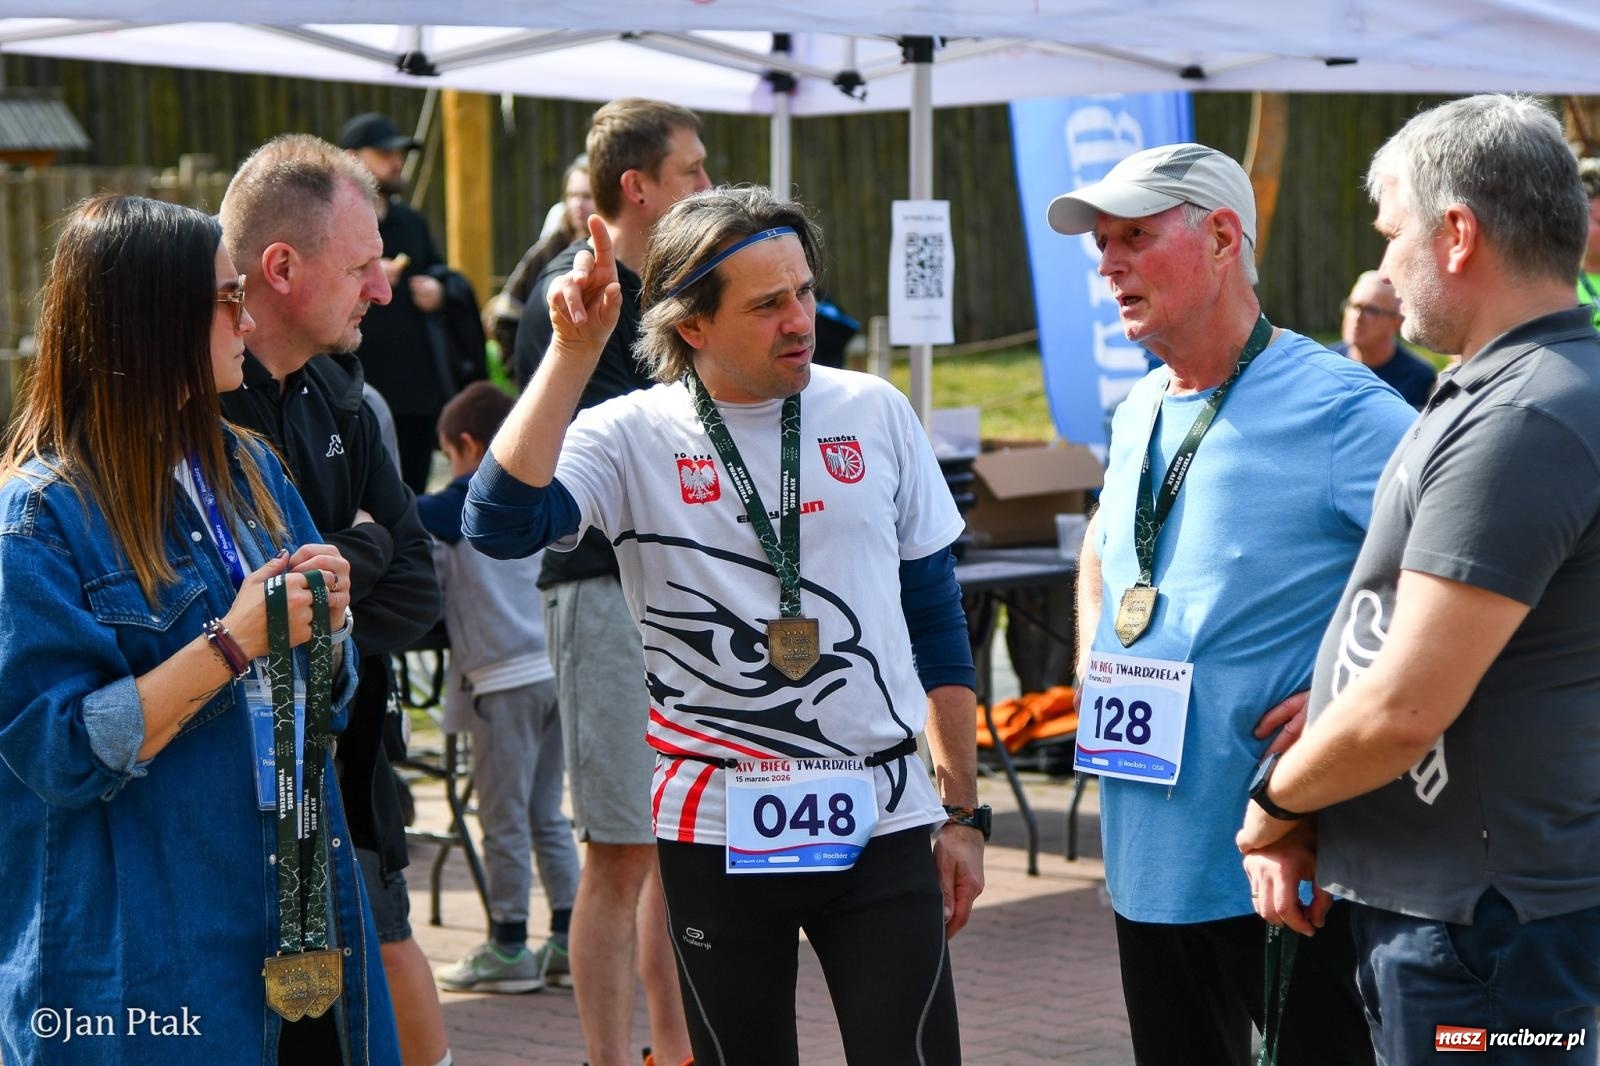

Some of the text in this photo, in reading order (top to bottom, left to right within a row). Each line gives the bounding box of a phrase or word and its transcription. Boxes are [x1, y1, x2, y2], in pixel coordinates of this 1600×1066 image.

[817, 435, 857, 443] RACIBÓRZ
[675, 453, 712, 461] POSKA
[1167, 456, 1184, 486] XIV BIEG
[727, 462, 750, 504] TWARDZIELA
[736, 466, 754, 495] XIV BIEG
[1170, 453, 1193, 496] TWARDZIELA
[1116, 663, 1180, 681] TWARDZIELA
[1094, 696, 1153, 745] 128
[736, 759, 863, 772] XIV BIEG TWARDZIELA
[771, 774, 791, 782] 2026
[278, 768, 287, 820] TWARDZIELA
[753, 792, 856, 838] 048
